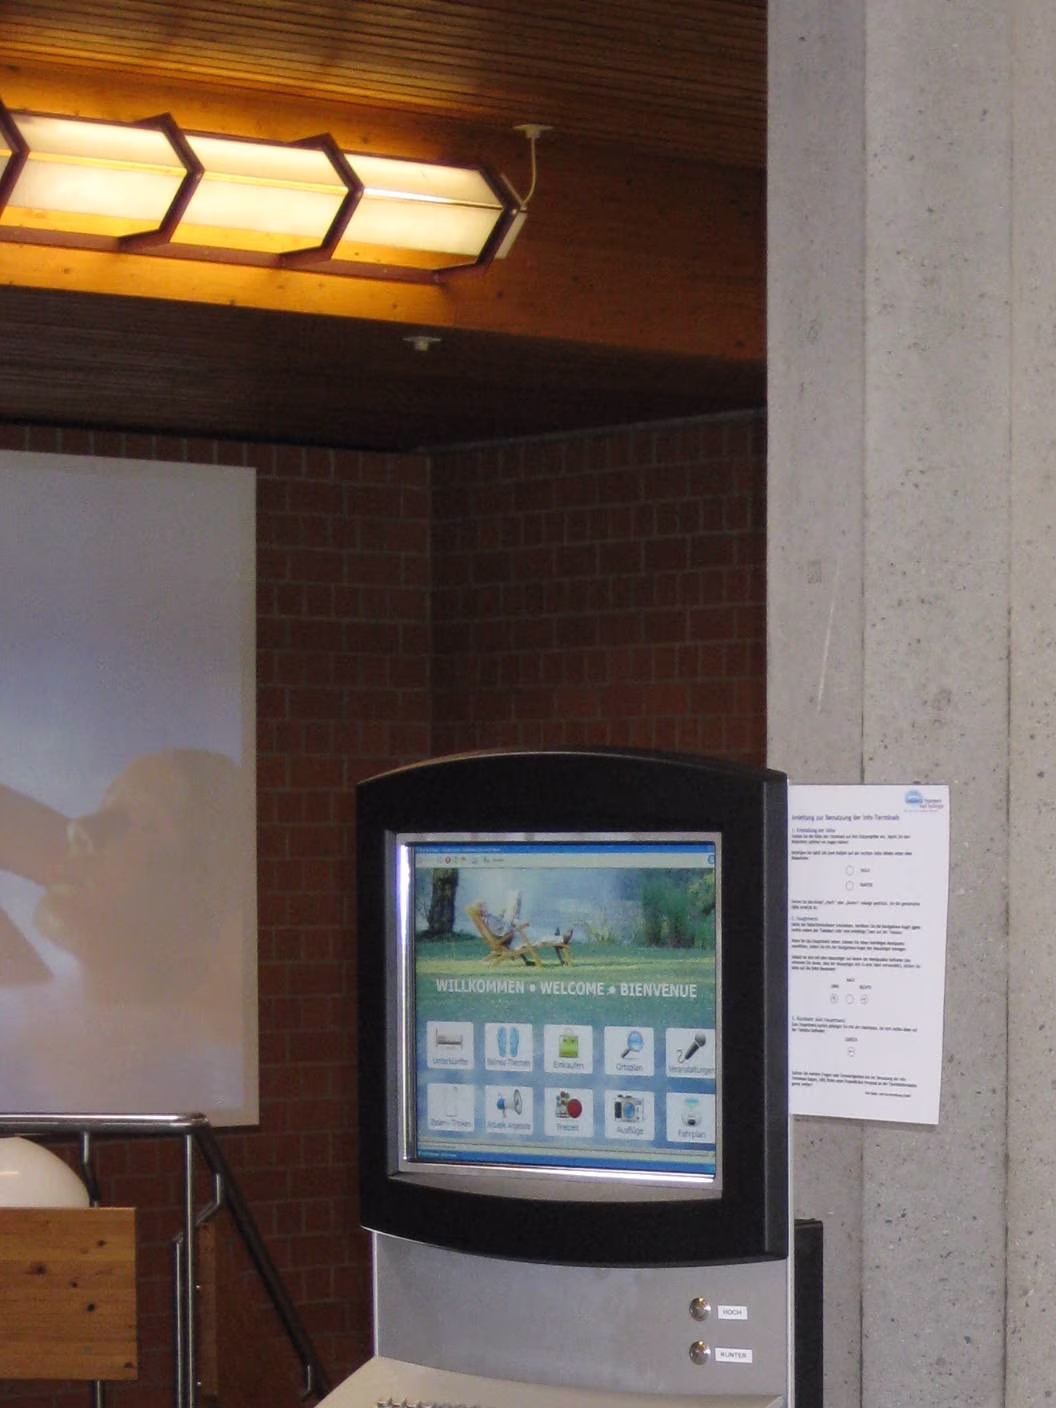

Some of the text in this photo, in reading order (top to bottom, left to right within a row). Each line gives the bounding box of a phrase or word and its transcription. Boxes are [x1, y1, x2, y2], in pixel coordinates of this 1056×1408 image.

[436, 978, 698, 998] WILLKOMMEN WELCOME BIENVENUE
